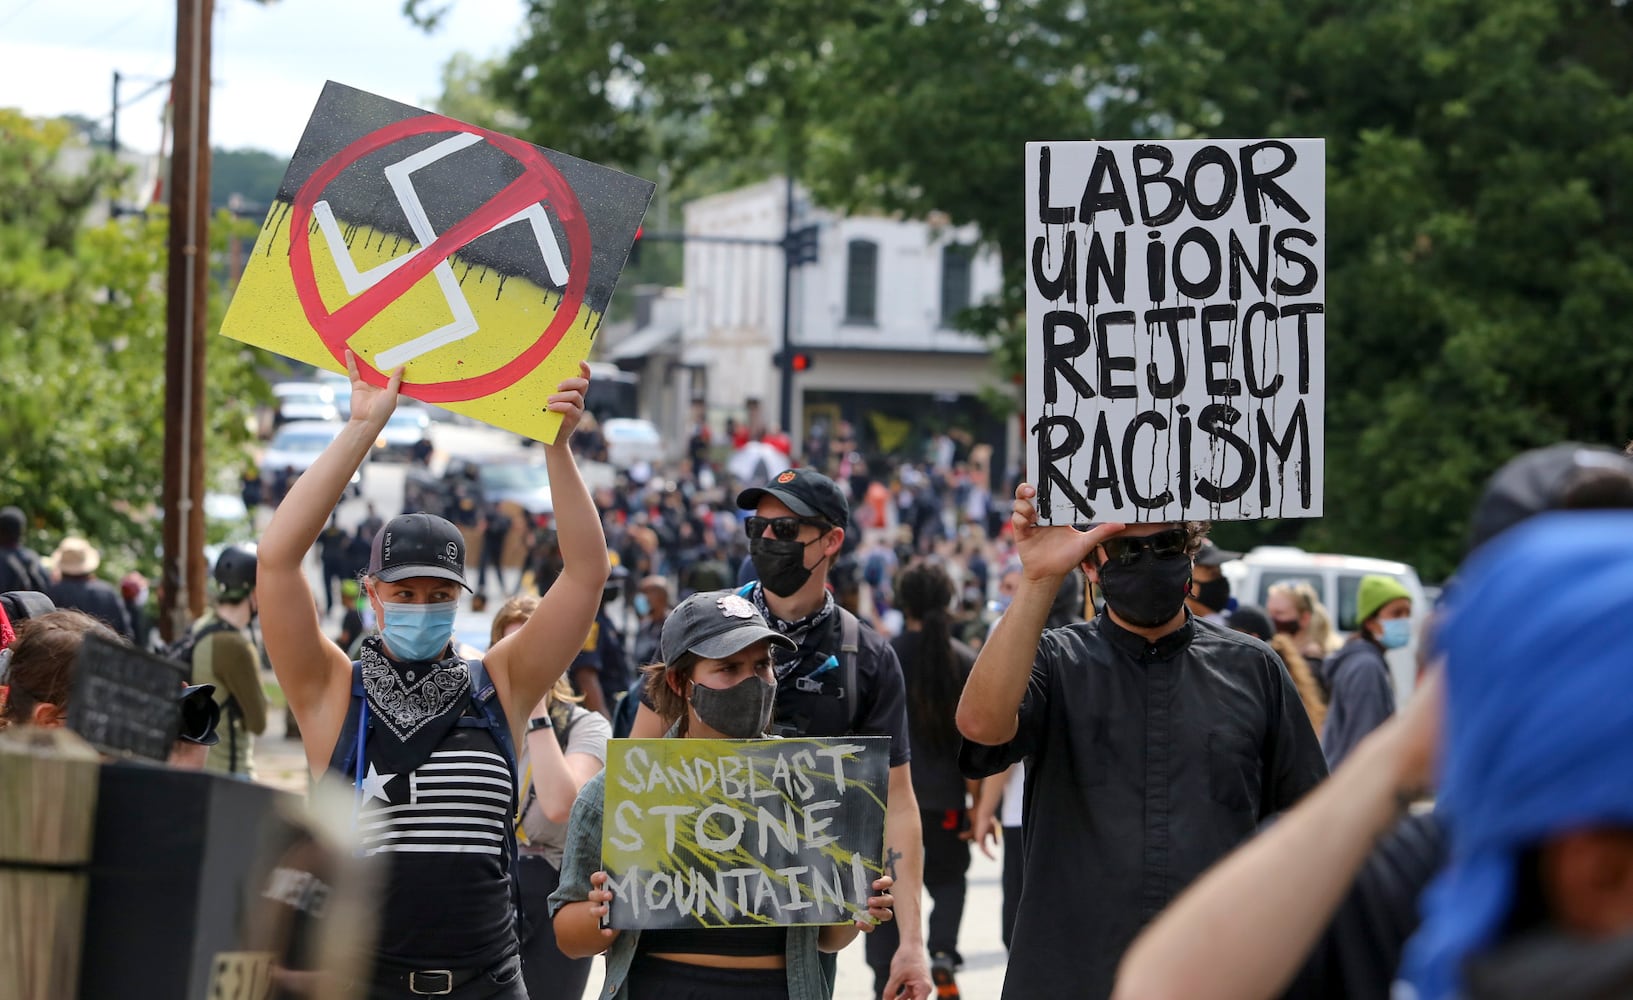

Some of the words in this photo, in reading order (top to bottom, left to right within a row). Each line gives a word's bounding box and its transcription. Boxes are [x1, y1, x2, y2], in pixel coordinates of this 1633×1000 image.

[1039, 140, 1311, 226] LABOR
[1043, 302, 1324, 404] REJECT
[619, 744, 866, 803] SANDBLAST
[609, 799, 841, 857] STONE
[602, 852, 877, 926] MOUNTAIN!
